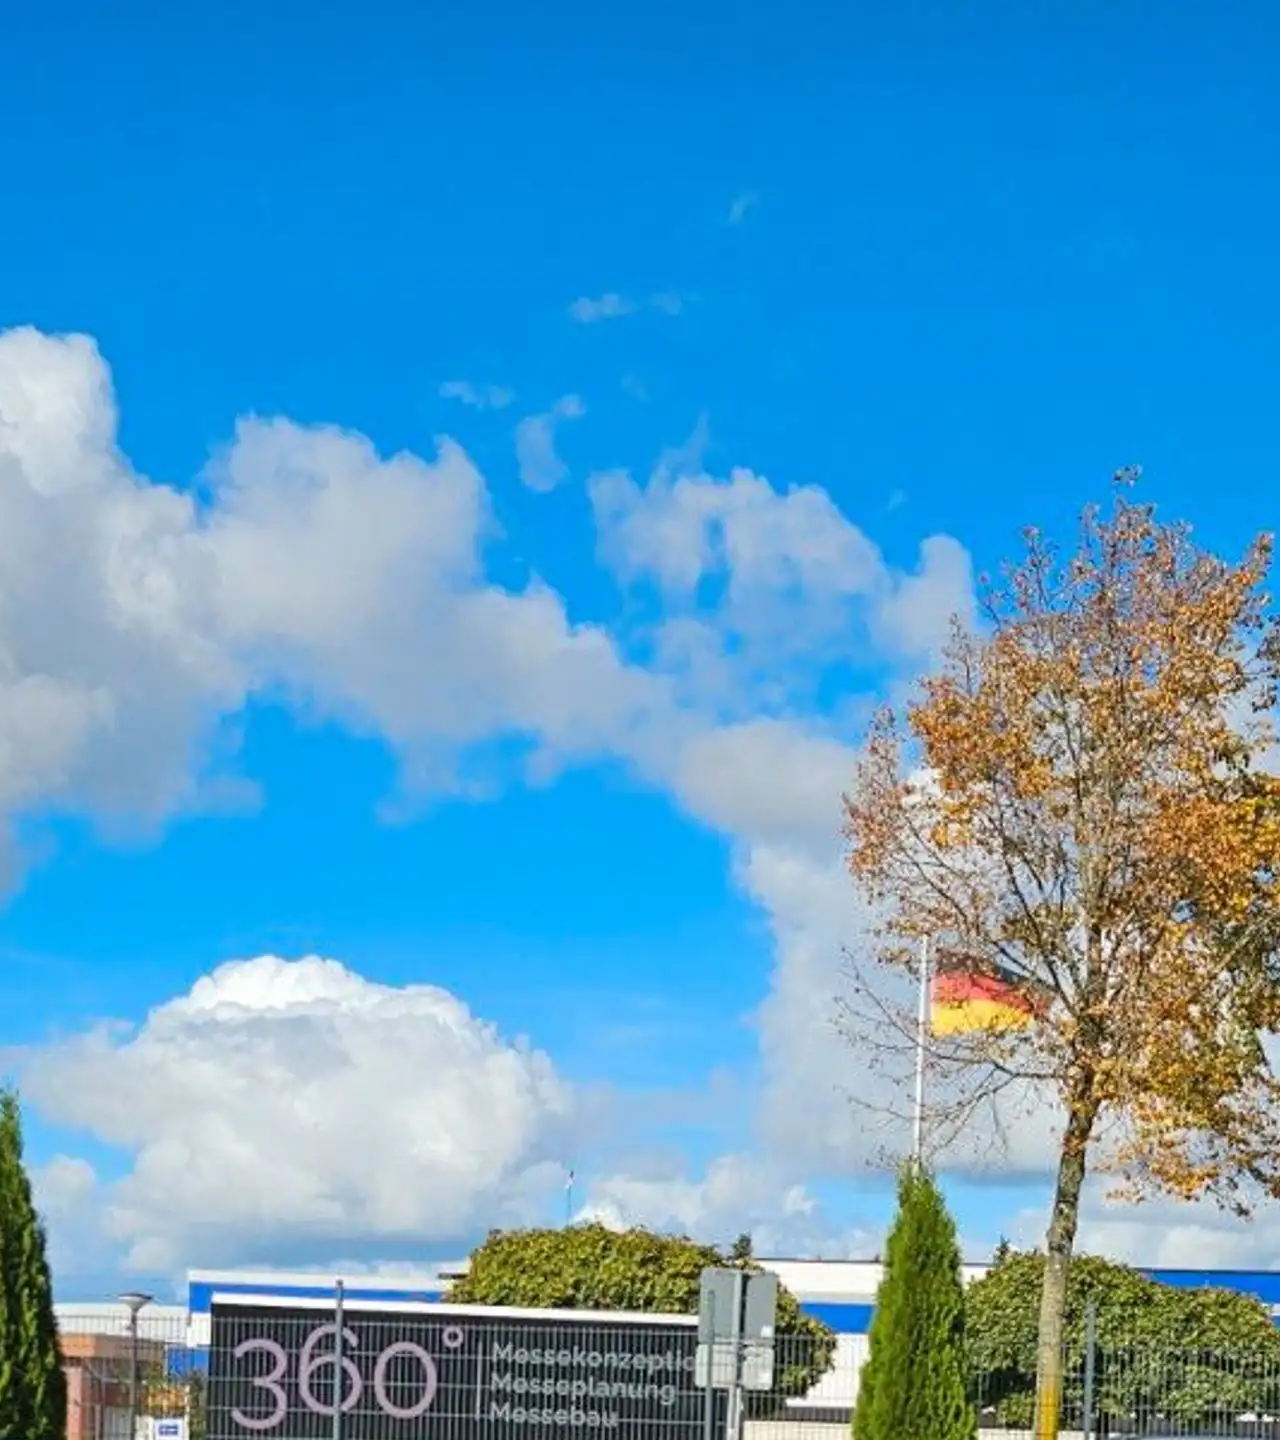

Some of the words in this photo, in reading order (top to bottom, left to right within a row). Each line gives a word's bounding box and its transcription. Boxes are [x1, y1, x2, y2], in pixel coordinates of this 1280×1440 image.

[492, 1341, 697, 1373] Messekonzeptio
[231, 1323, 464, 1430] 360°
[491, 1372, 677, 1405] Messeplanung
[490, 1402, 619, 1428] Messebau
